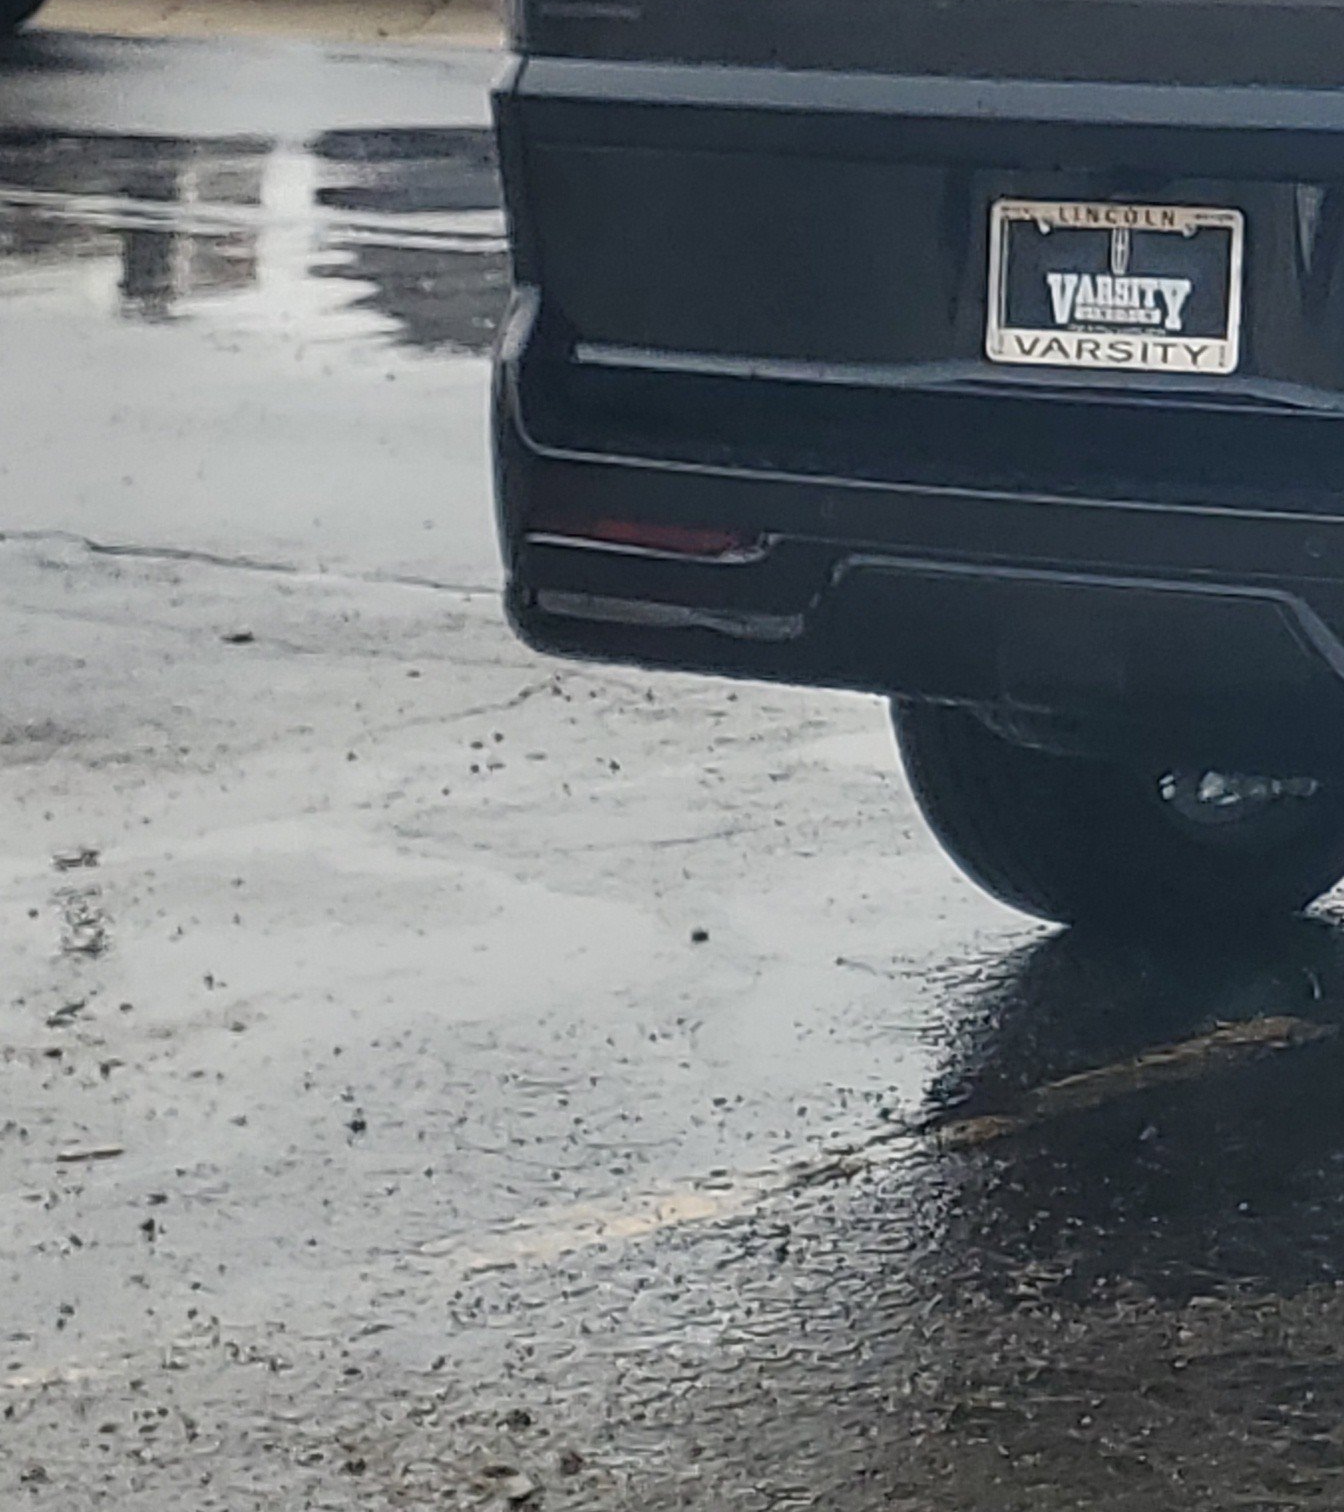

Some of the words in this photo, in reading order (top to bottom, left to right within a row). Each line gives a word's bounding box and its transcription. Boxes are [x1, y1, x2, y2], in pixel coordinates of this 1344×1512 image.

[1058, 205, 1176, 227] LINCOLN
[1046, 272, 1192, 331] VARSITY
[1014, 334, 1209, 367] VARSITY
